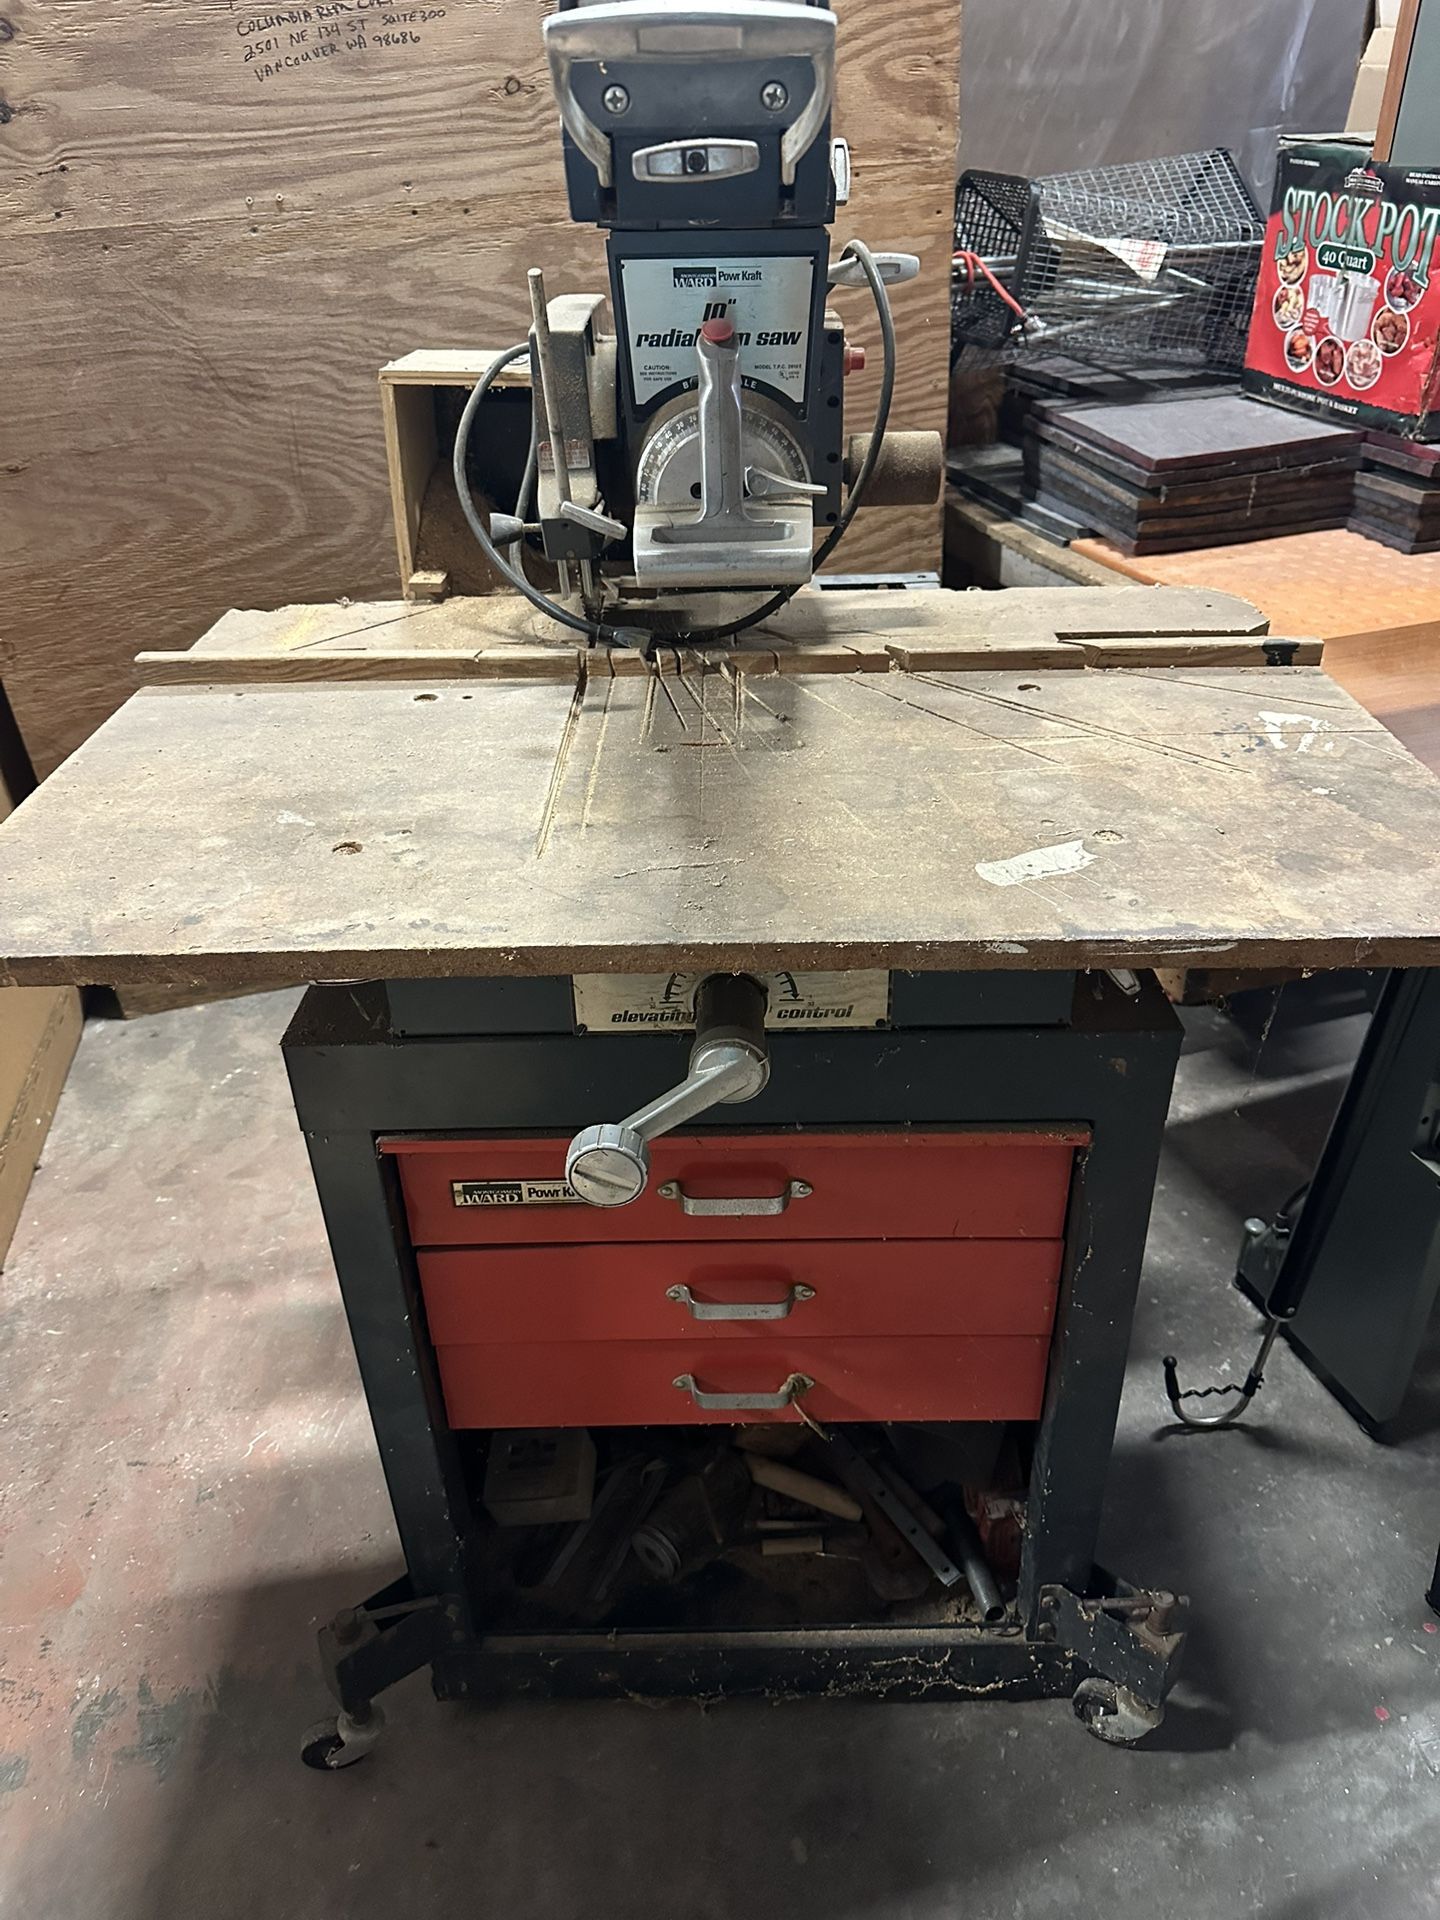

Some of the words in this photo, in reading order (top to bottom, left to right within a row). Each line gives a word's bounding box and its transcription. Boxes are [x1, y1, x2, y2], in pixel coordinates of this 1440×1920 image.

[237, 10, 312, 36] COLUMBIA
[243, 37, 279, 62] 2501
[289, 29, 309, 47] NE
[318, 22, 341, 39] 134
[347, 19, 369, 32] ST
[254, 43, 340, 82] VANCOUVER
[346, 34, 367, 50] WA
[372, 31, 421, 48] 98686
[1275, 187, 1375, 262] STOCK
[1373, 201, 1440, 291] POT
[1322, 251, 1337, 264] 40
[1338, 251, 1369, 270] Quart
[674, 277, 714, 287] WARD
[718, 271, 740, 281] Powr
[742, 270, 762, 281] Kraft
[636, 328, 700, 348] radial
[756, 330, 802, 346] saw
[611, 1008, 697, 1024] elevating
[776, 1005, 854, 1019] control
[464, 1193, 519, 1204] WARD
[527, 1187, 560, 1198] Powr
